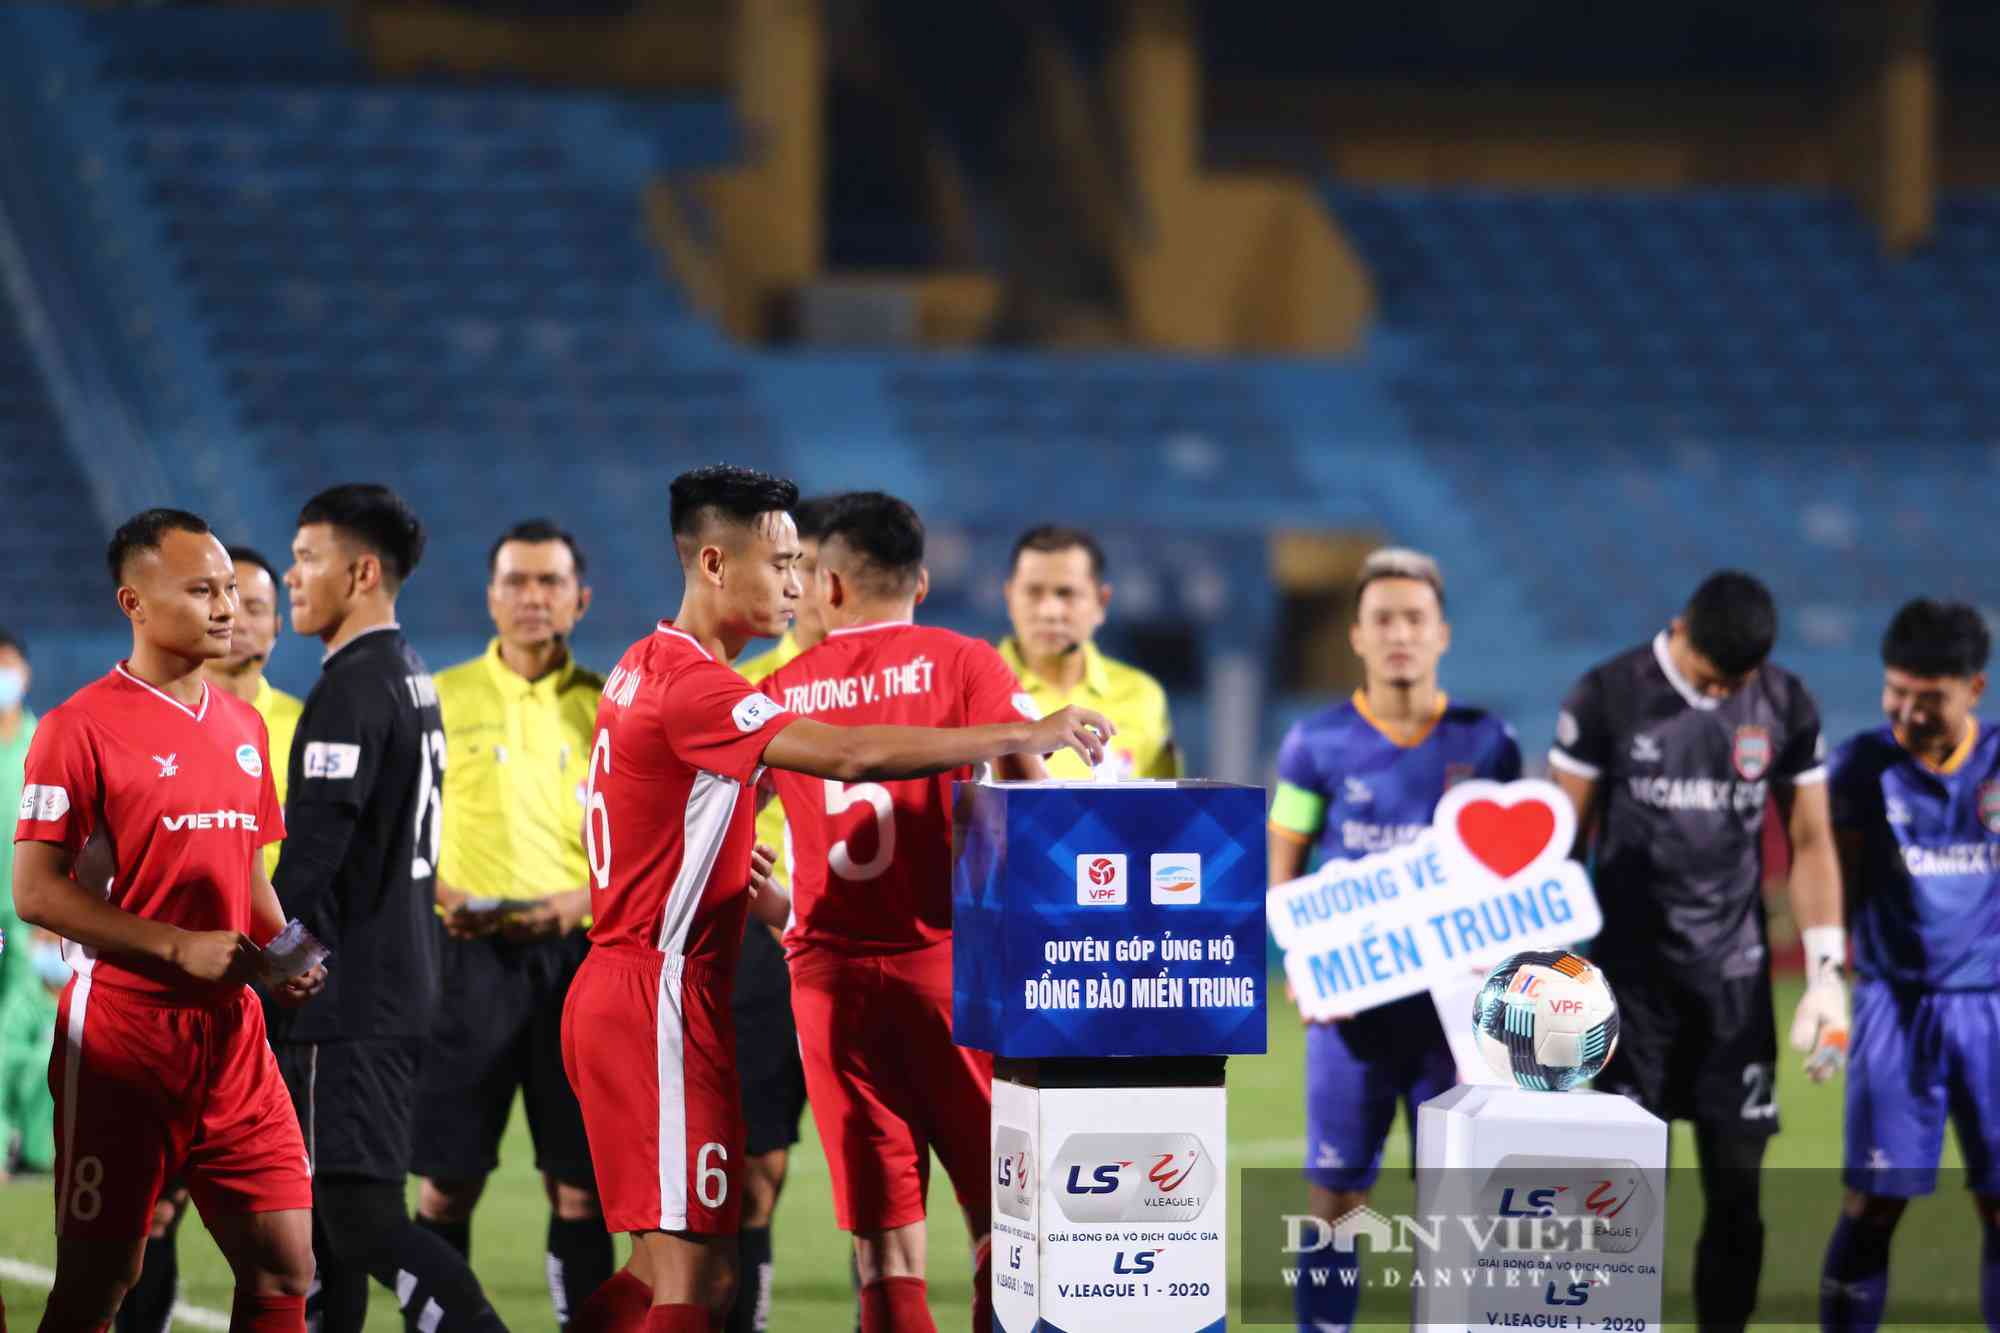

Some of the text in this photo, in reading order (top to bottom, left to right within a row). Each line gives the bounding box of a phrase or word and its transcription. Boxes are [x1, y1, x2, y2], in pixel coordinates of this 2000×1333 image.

[861, 674, 880, 704] V.
[824, 779, 896, 881] 5
[1088, 888, 1116, 900] VPF
[1428, 879, 1573, 960] TRUNG
[1044, 931, 1235, 965] QUYÊN GÓP ỦNG HỘ
[1025, 967, 1254, 1009] ĐỒNG BÀO MIỀN TRUNG
[1549, 1000, 1584, 1014] VPF
[695, 1143, 728, 1208] 6
[998, 1157, 1012, 1187] LS
[1066, 1165, 1121, 1194] LS
[69, 1156, 103, 1221] 8
[1144, 1198, 1195, 1207] V.LEAGUE
[1499, 1188, 1556, 1217] LS
[1200, 1232, 1218, 1241] GIA
[1009, 1245, 1021, 1269] LS
[1113, 1251, 1156, 1275] LS
[1057, 1284, 1136, 1298] V.LEAGUE
[1143, 1284, 1149, 1297] 1
[1168, 1283, 1210, 1297] 2020
[1545, 1281, 1590, 1306] LS
[1487, 1312, 1568, 1329] V.LEAGUE
[1576, 1316, 1581, 1329] 1
[1602, 1317, 1646, 1333] 2020
